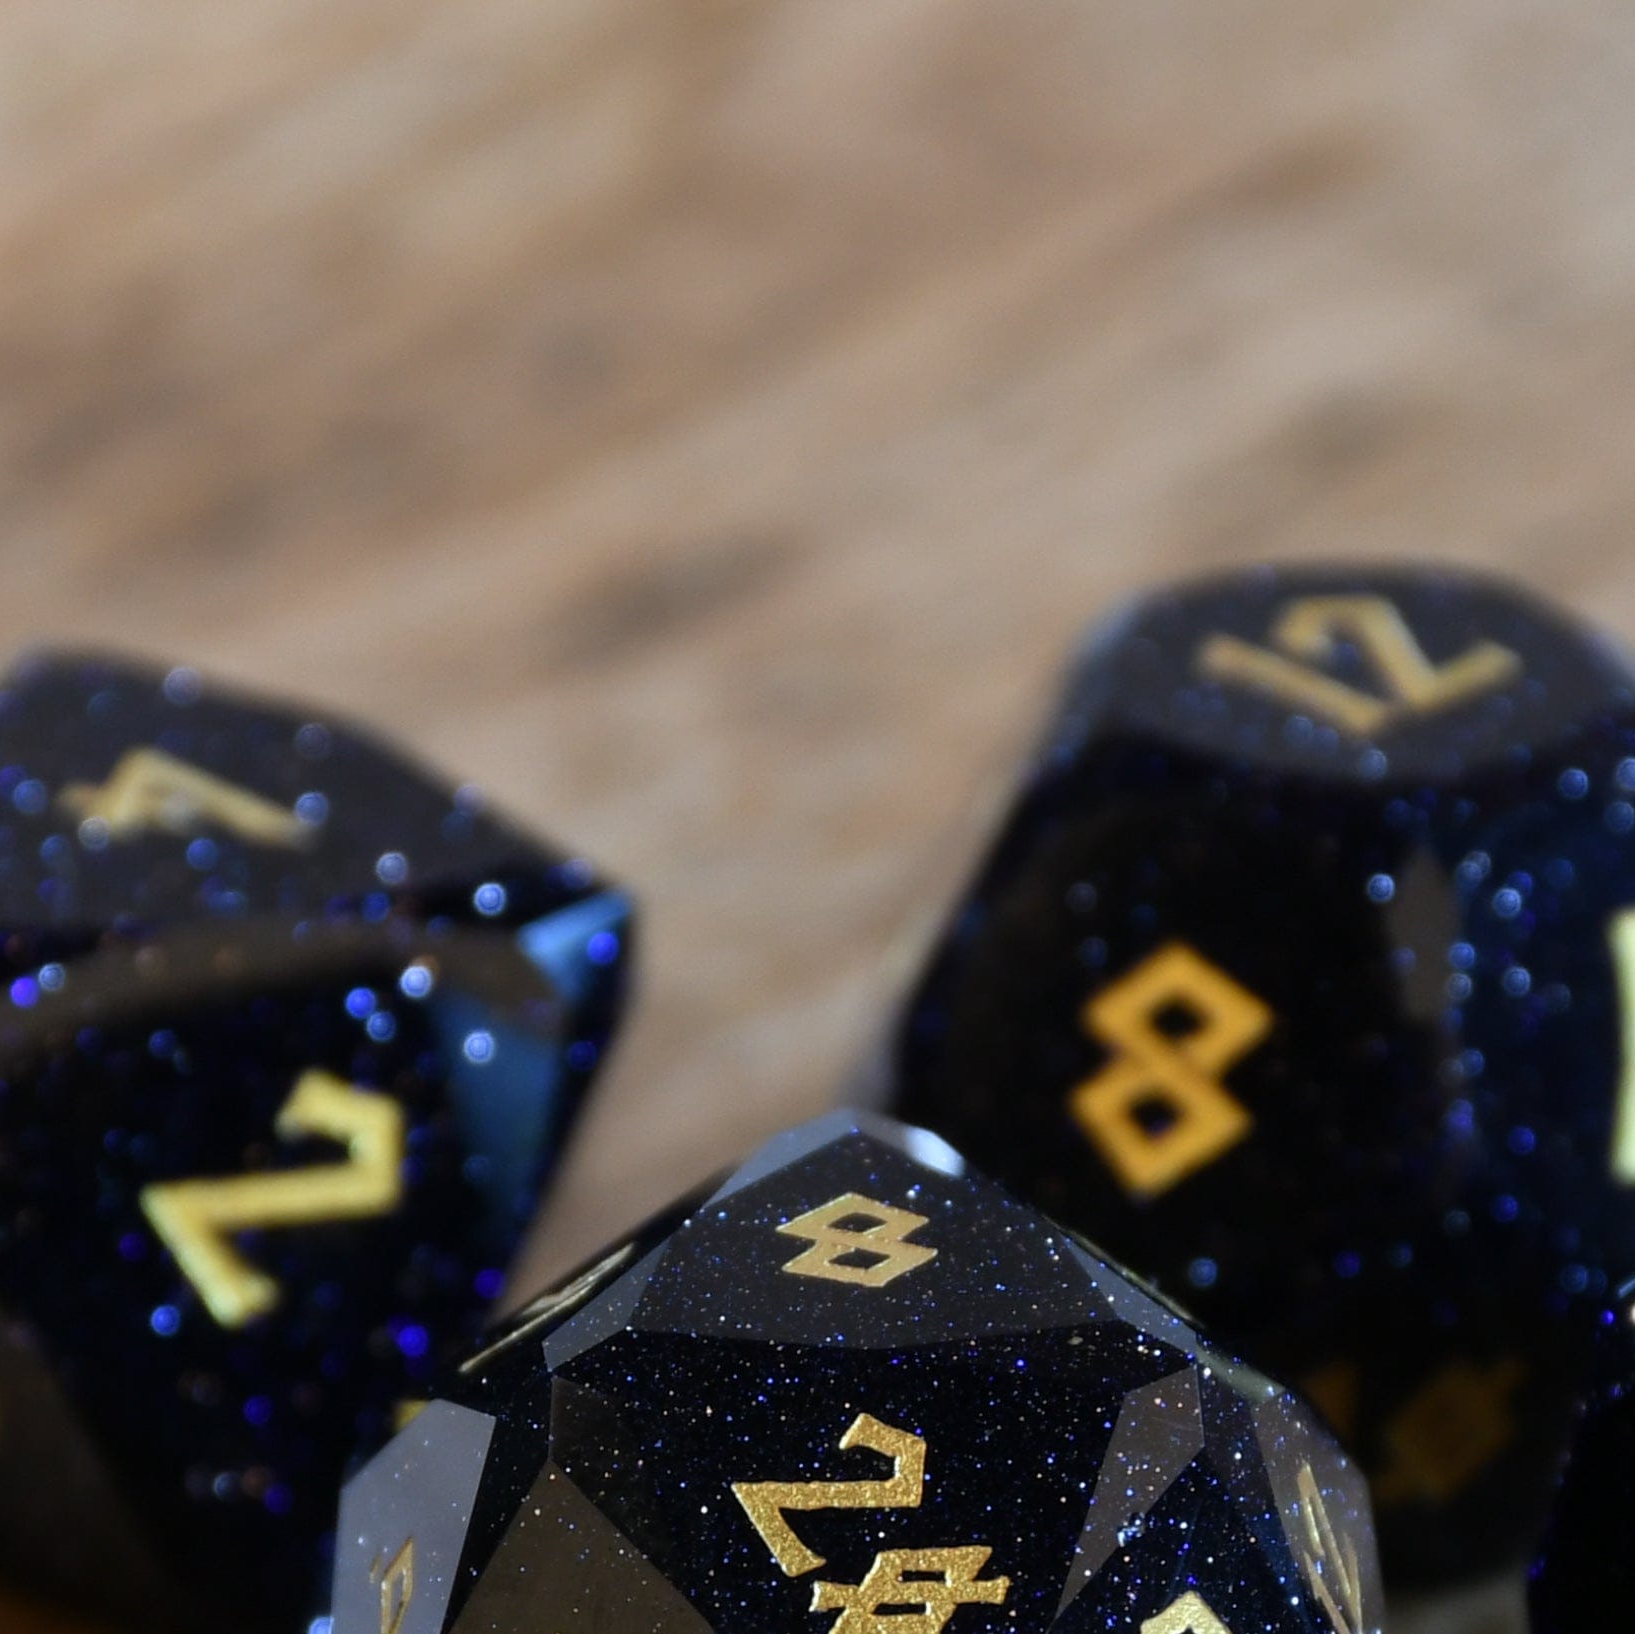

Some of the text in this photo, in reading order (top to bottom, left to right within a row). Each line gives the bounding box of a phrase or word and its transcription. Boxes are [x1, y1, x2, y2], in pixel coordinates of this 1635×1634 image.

[1204, 594, 1512, 738] 12
[1068, 940, 1274, 1194] 8
[140, 1068, 406, 1328] 2
[777, 1191, 938, 1289] 8
